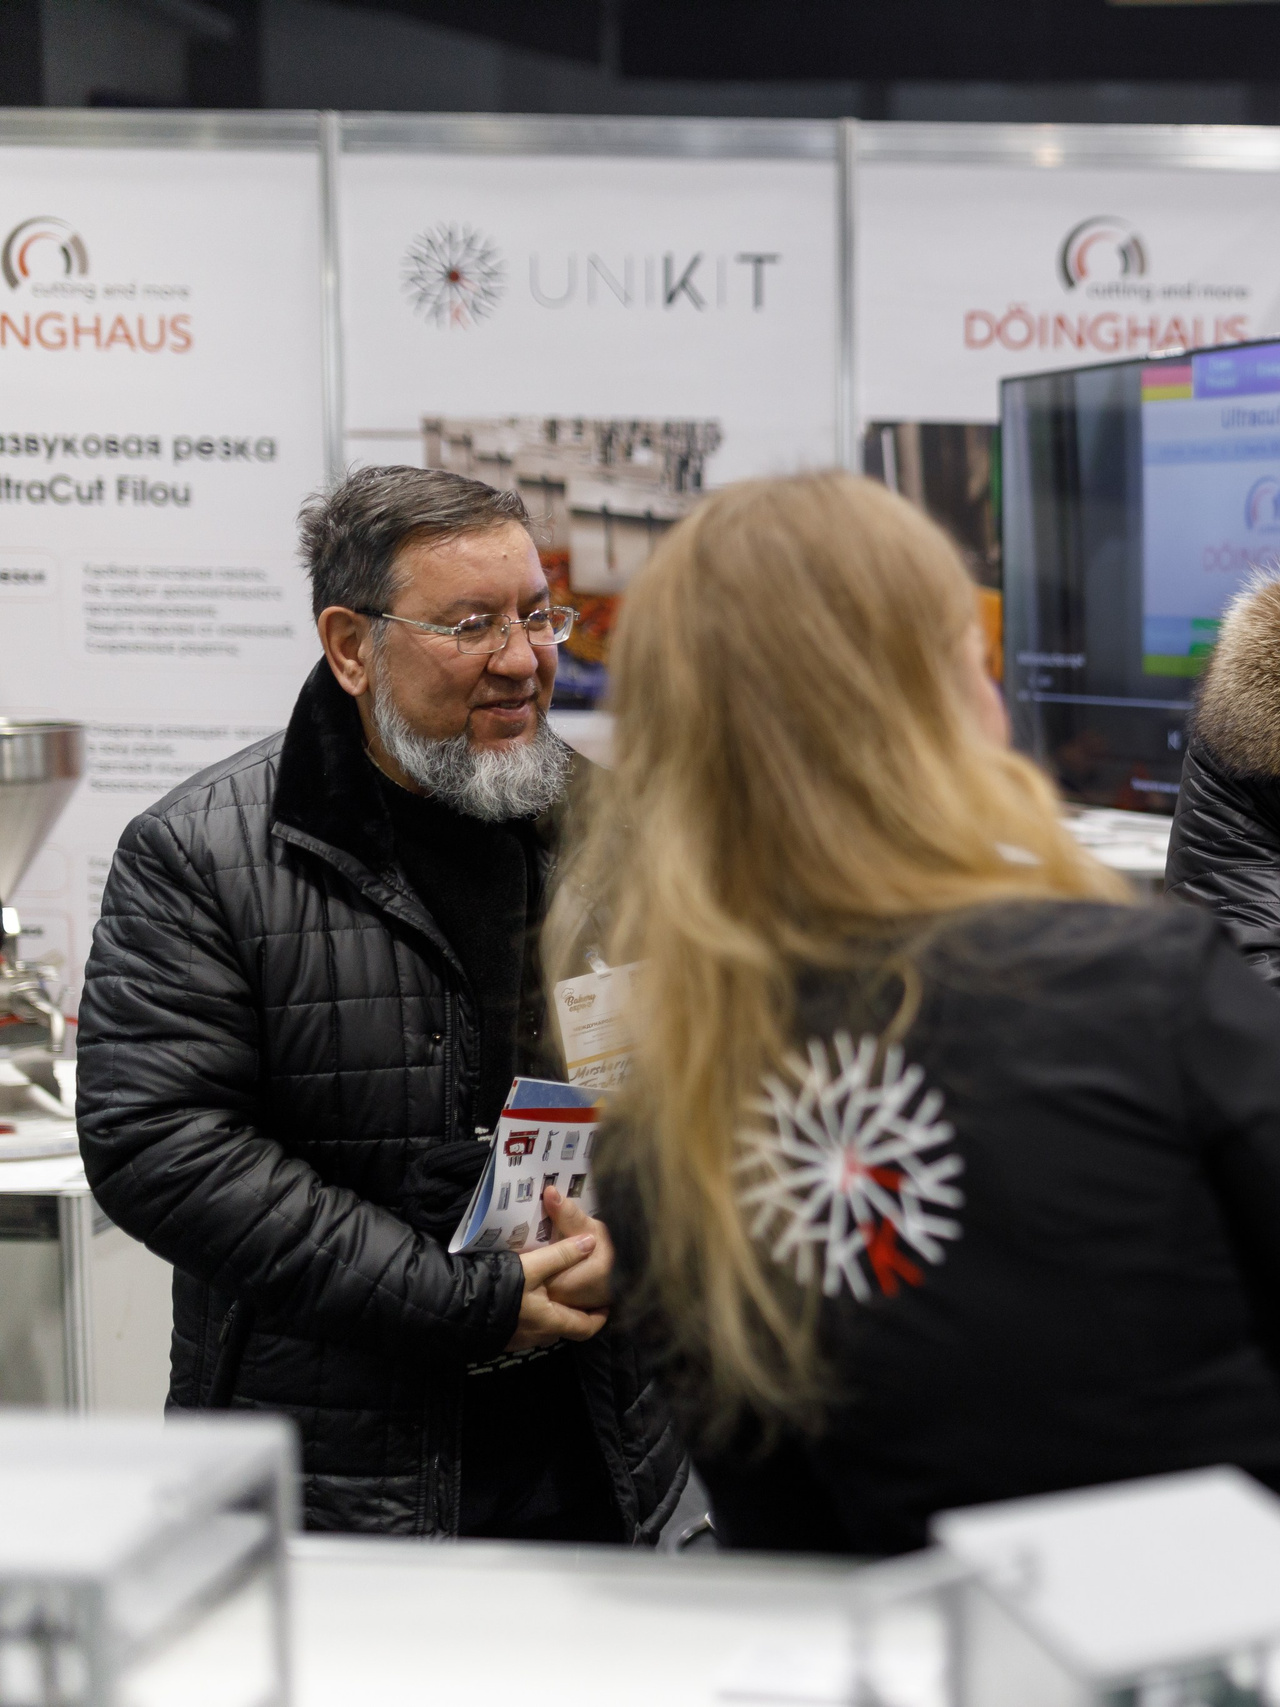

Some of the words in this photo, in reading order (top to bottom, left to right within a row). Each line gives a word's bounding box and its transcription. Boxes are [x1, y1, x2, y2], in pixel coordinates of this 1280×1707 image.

[528, 251, 783, 312] UNIKIT
[0, 433, 162, 462] звуковая
[172, 436, 278, 464] резка
[115, 475, 192, 507] Filou
